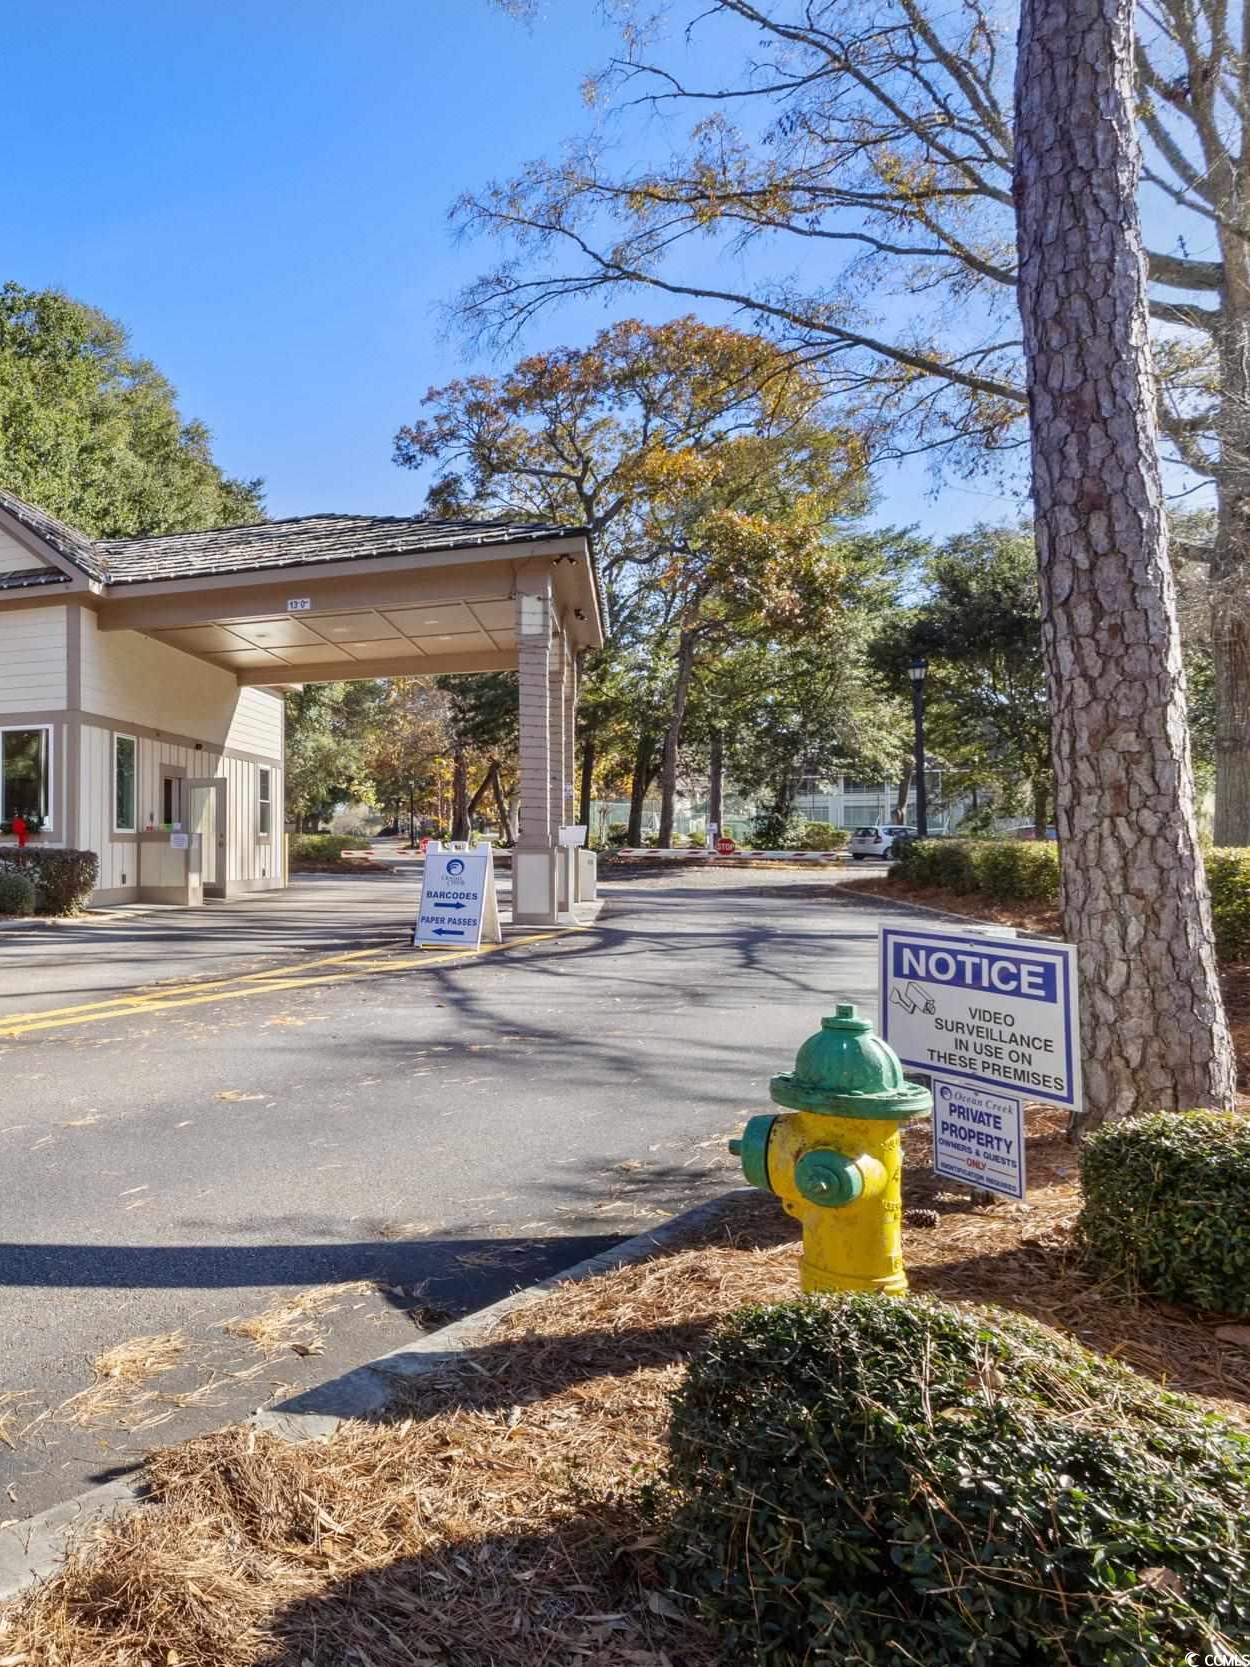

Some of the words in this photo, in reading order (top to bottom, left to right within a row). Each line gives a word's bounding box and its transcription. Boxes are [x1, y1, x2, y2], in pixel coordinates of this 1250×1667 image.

[426, 890, 478, 900] BARCODES
[421, 916, 446, 925] PAPER
[447, 917, 478, 926] PASSES
[902, 947, 1046, 997] NOTICE
[968, 1007, 1015, 1027] VIDEO
[934, 1017, 1055, 1053] SURVEILLANCE
[954, 1038, 969, 1051] IN
[973, 1042, 1004, 1060] USE
[1008, 1050, 1032, 1066] ON
[927, 1049, 977, 1070] THESE
[981, 1061, 1065, 1091] PREMISES
[949, 1103, 1002, 1130] PRIVATE
[954, 1091, 983, 1107] Ocean
[985, 1100, 1014, 1115] Creek
[941, 1120, 1013, 1154] PROPERTY
[939, 1138, 972, 1154] OWNERS
[975, 1149, 981, 1157] &
[983, 1151, 1017, 1168] GUESTS
[966, 1158, 987, 1171] ONLY
[940, 1162, 984, 1181] IDENTIFICATION
